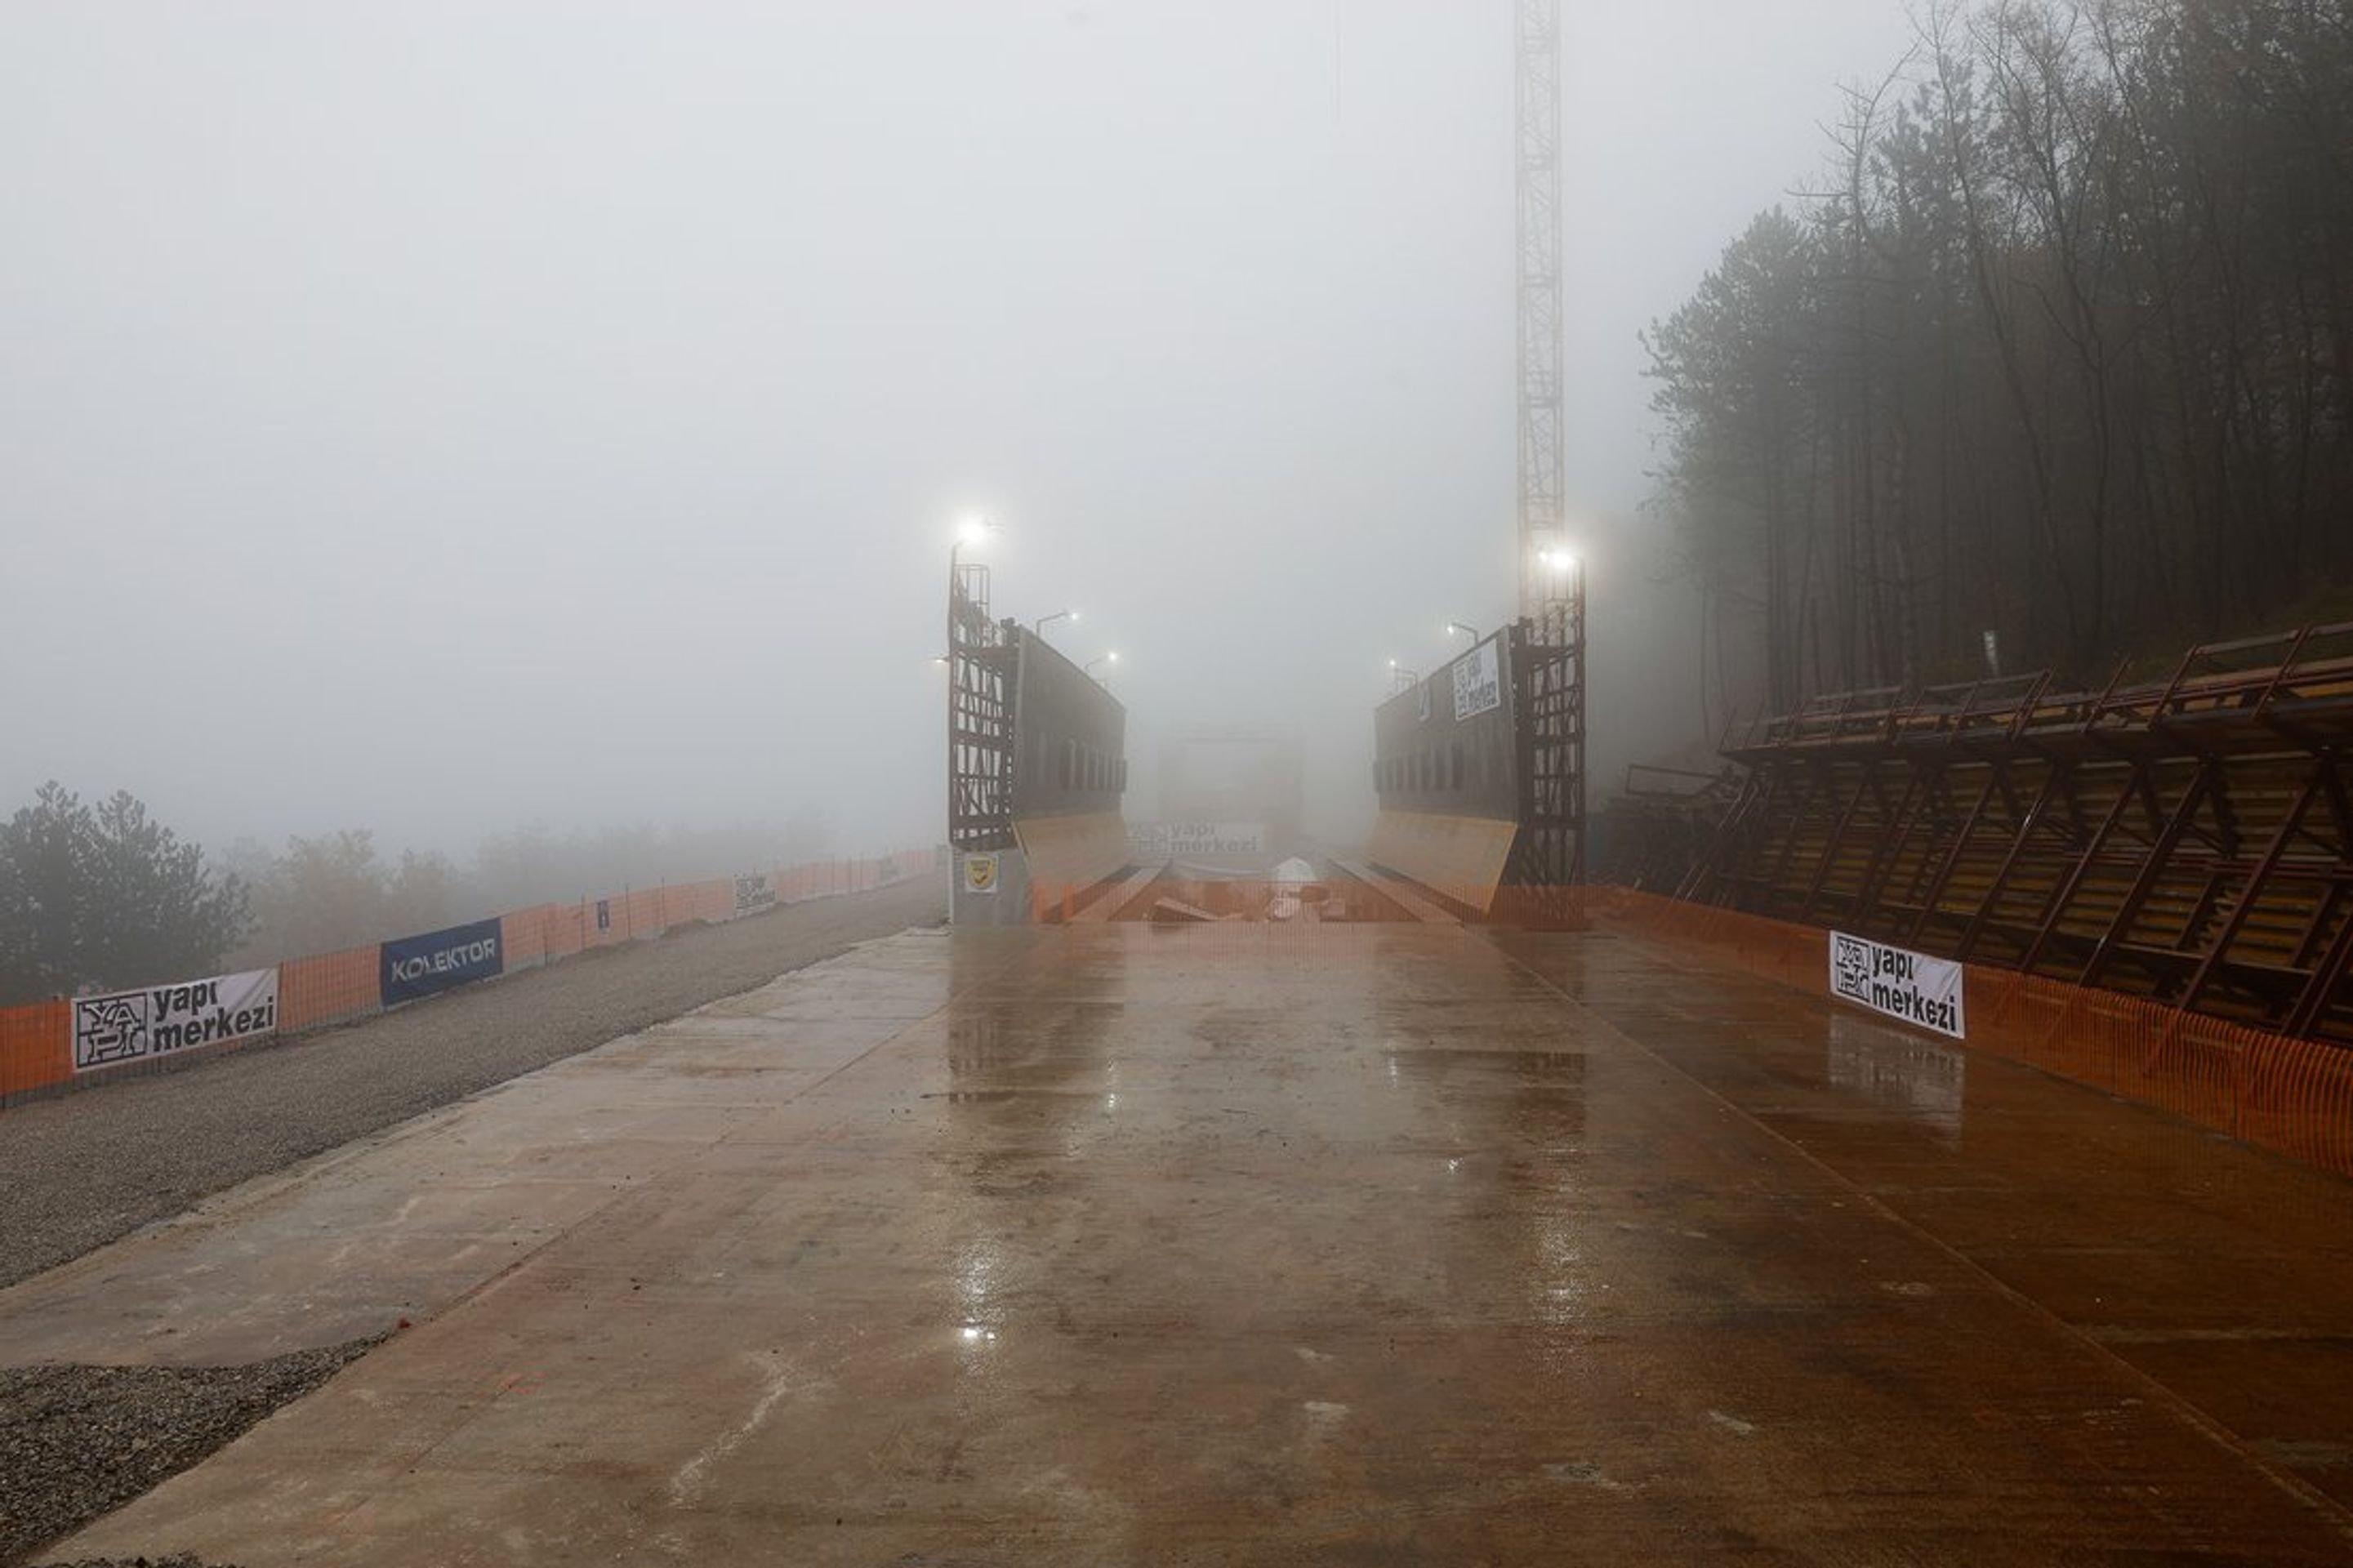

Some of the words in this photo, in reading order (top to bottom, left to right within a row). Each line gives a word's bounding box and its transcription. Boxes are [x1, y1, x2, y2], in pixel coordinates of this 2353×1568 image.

[391, 938, 495, 982] KOLEKTOR
[1872, 947, 1914, 983] yapı
[153, 982, 219, 1021] yapı
[1872, 982, 1957, 1031] merkezi
[153, 996, 274, 1052] merkezi
